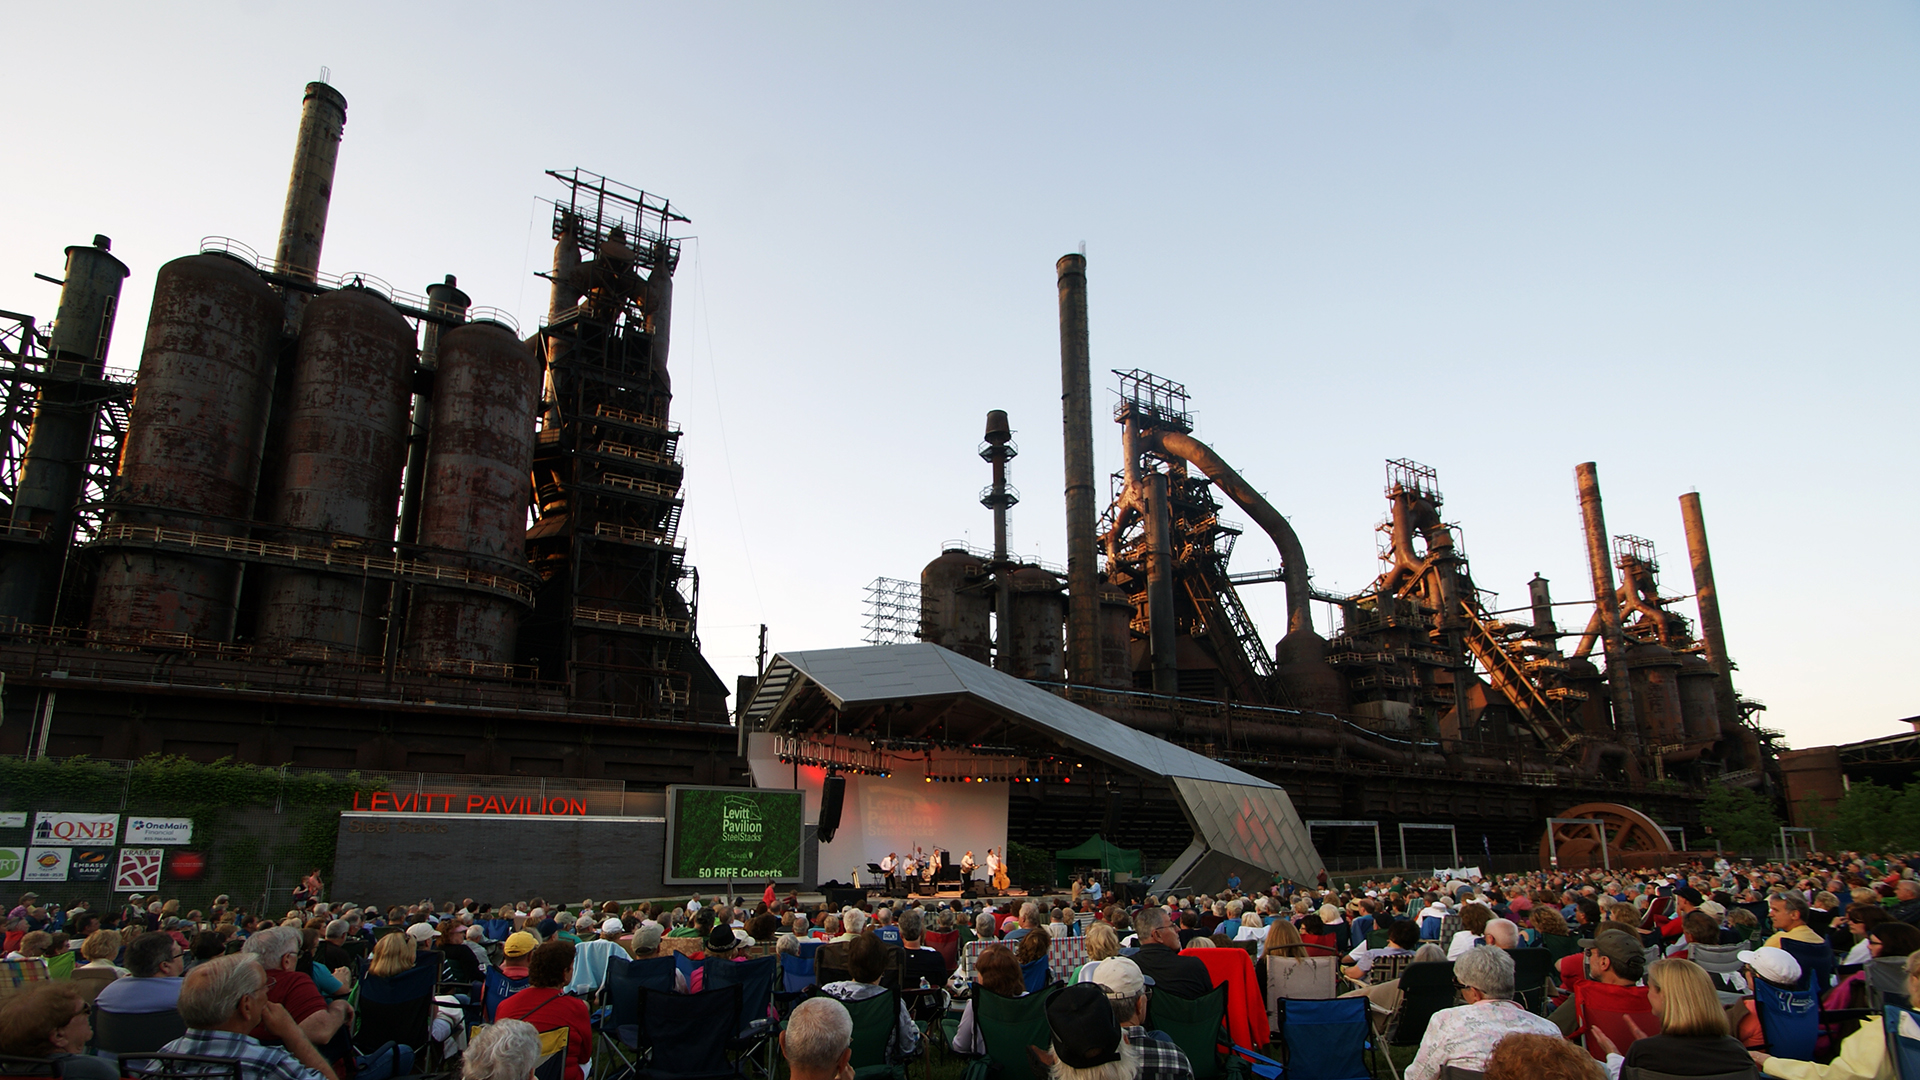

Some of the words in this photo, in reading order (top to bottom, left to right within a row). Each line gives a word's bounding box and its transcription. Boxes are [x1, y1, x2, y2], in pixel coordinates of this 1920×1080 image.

[352, 791, 457, 813] LEVITT
[466, 795, 587, 816] PAVILION
[723, 806, 750, 819] Levitt
[867, 811, 932, 826] Pavilion
[53, 820, 114, 841] QNB
[145, 821, 188, 830] OneMain
[348, 820, 390, 833] Steel
[396, 820, 449, 834] Stacks
[723, 819, 762, 832] Pavilion
[722, 832, 761, 842] SteelStacks
[0, 859, 20, 870] RT
[699, 868, 711, 878] 50
[741, 868, 783, 878] Concerts
